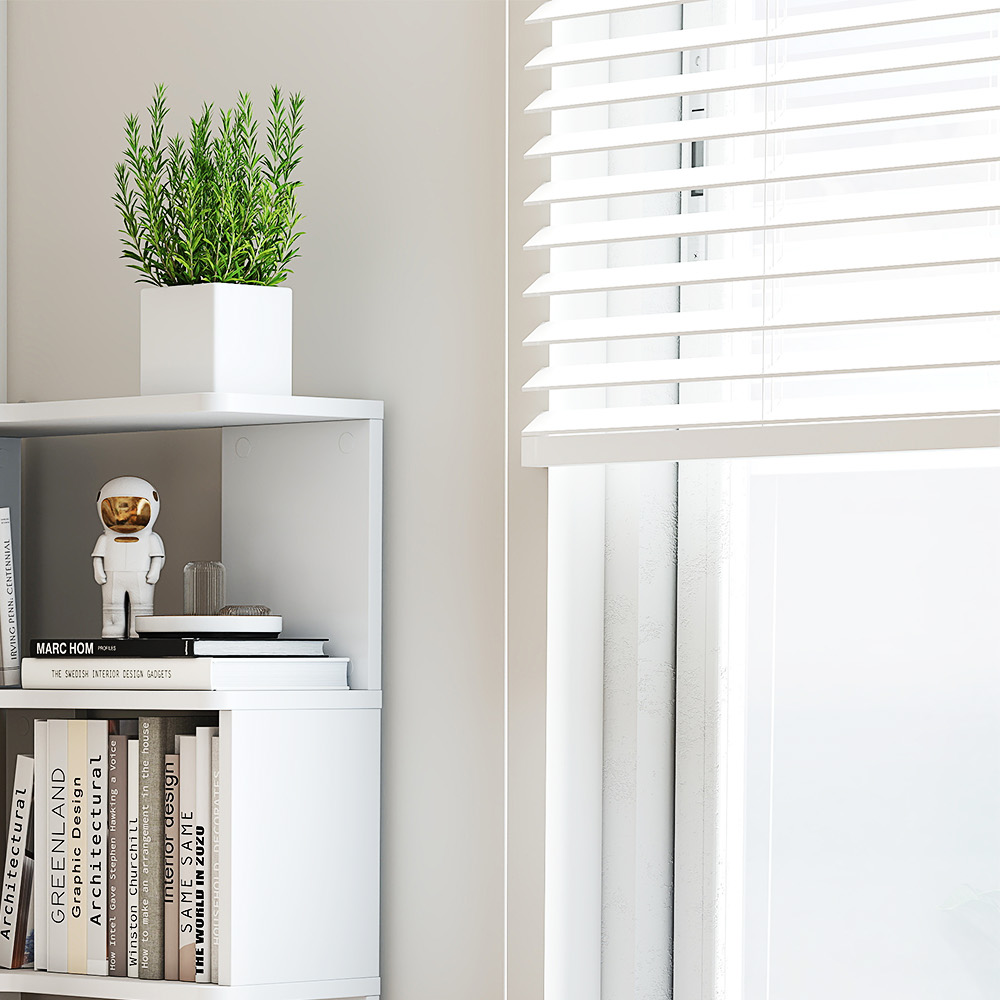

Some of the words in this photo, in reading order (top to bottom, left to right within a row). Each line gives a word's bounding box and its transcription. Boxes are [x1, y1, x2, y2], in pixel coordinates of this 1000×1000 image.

[3, 538, 13, 595] CENTENNIAL
[9, 626, 18, 660] IRVING
[36, 642, 67, 655] MARC
[69, 642, 94, 655] HOM
[52, 669, 62, 678] THE
[92, 669, 120, 678] INTERIOR
[122, 669, 144, 678] DESIGN
[146, 669, 172, 678] GADGETS
[141, 722, 150, 754] house
[141, 760, 150, 778] the
[72, 776, 82, 839] Design
[110, 788, 118, 832] Hawking
[141, 786, 150, 798] in
[51, 768, 66, 924] GREENLAND
[90, 755, 102, 926] Architectural
[110, 838, 118, 880] Stephen
[129, 817, 138, 896] Churchill
[141, 804, 151, 874] arrangement
[181, 811, 193, 866] SAME
[0, 788, 28, 941] Architectural
[72, 847, 82, 918] Graphic
[141, 880, 150, 893] an
[141, 898, 150, 925] make
[181, 878, 193, 934] SAME
[129, 905, 138, 966] Winston
[141, 930, 150, 942] to
[141, 948, 150, 969] How
